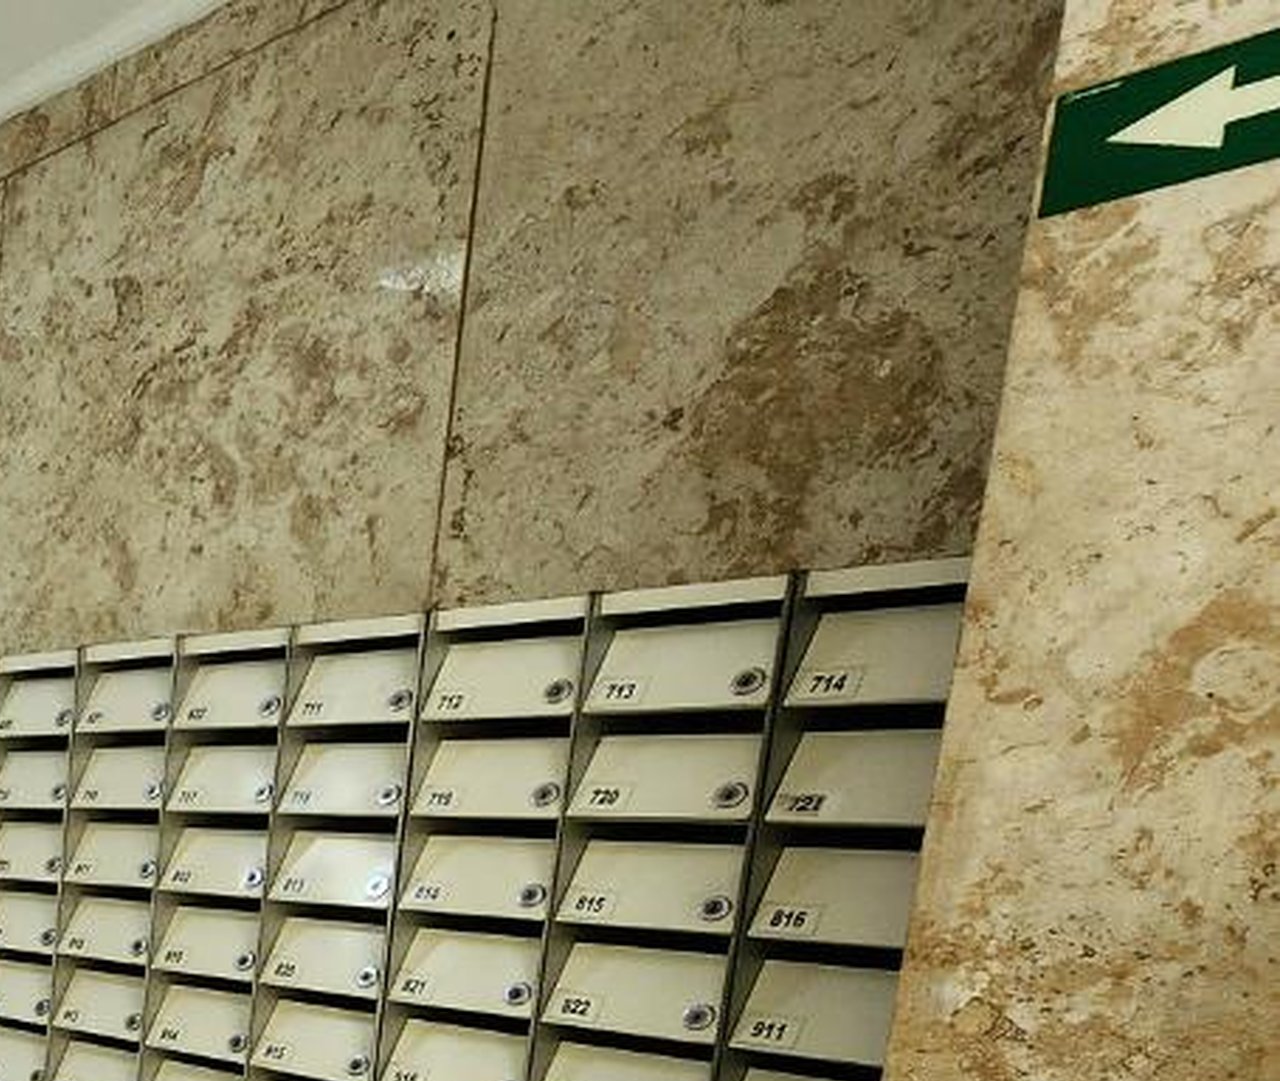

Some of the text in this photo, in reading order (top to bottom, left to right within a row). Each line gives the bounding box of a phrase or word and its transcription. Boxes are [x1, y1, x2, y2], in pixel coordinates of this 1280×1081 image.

[810, 674, 847, 692] 714
[606, 684, 636, 699] 713
[590, 789, 619, 805] 720
[576, 896, 606, 912] 815
[770, 910, 807, 927] 816
[402, 979, 426, 994] 821
[562, 999, 590, 1016] 822
[751, 1021, 787, 1040] 911
